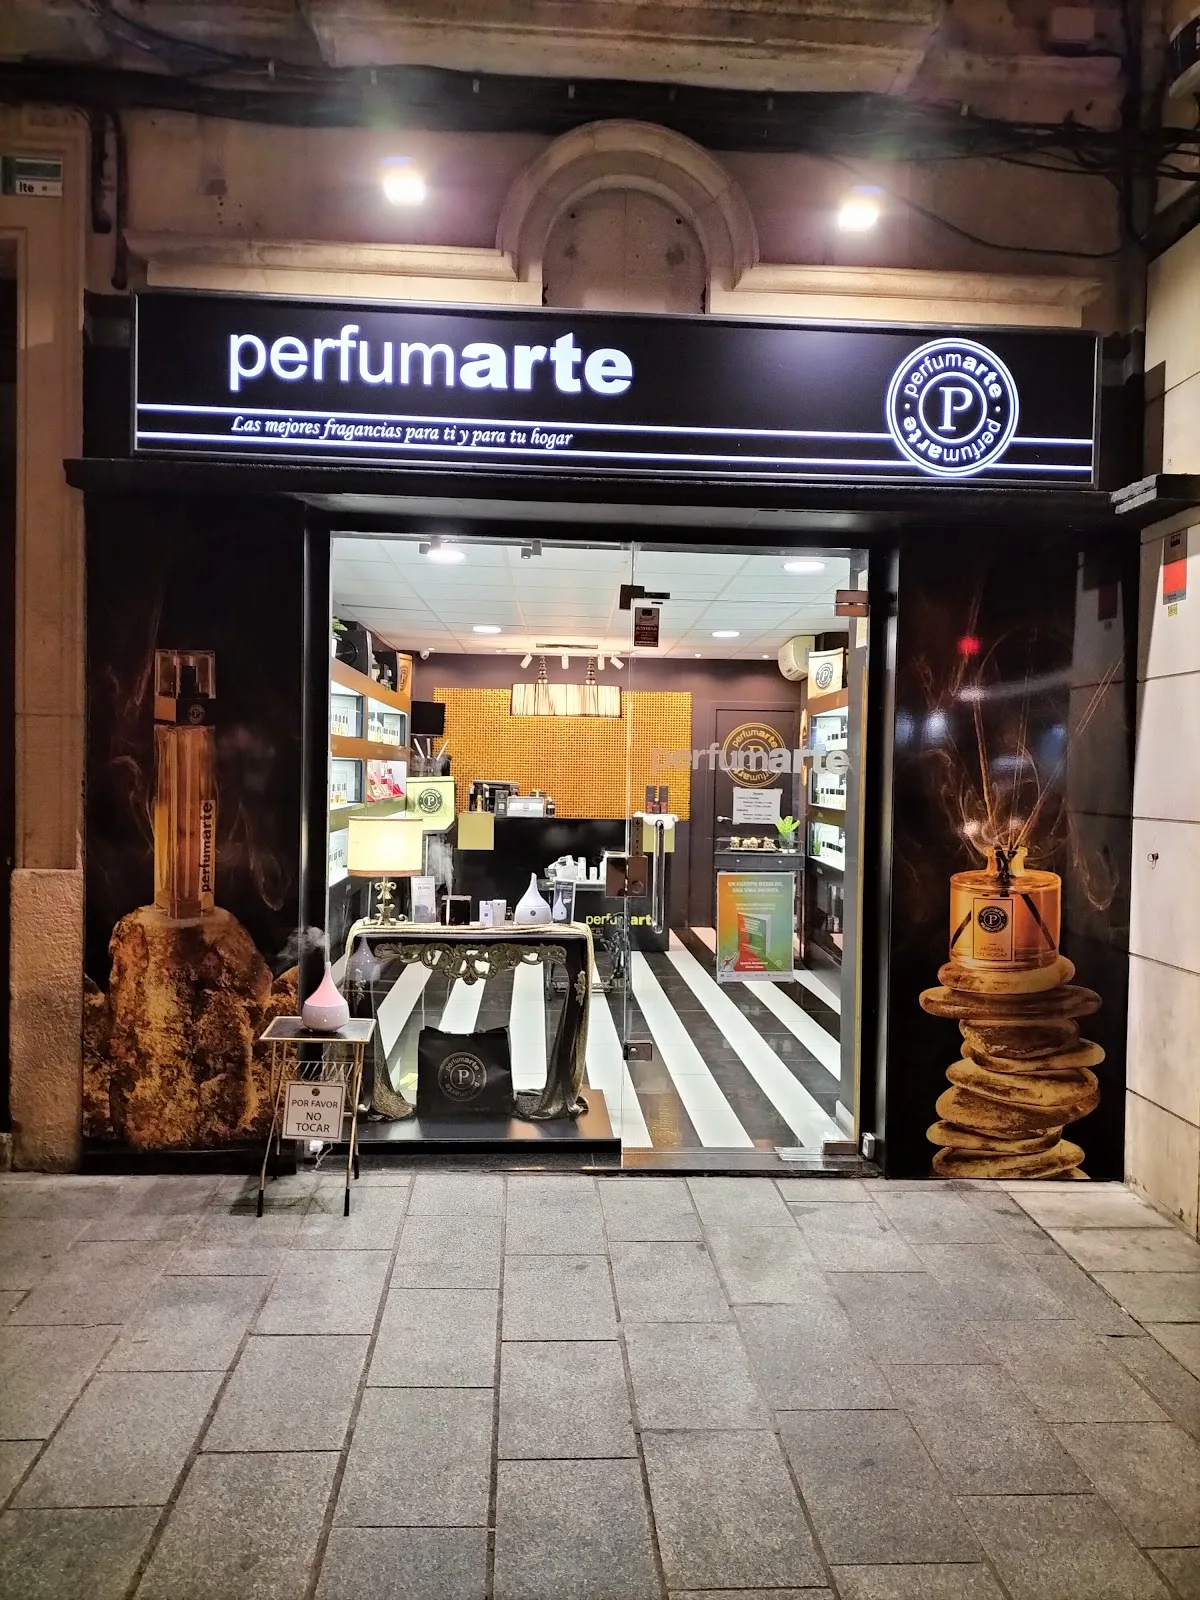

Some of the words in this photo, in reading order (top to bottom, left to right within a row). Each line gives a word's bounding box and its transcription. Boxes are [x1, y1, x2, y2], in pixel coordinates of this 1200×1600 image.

[229, 324, 633, 394] perfumarte
[903, 353, 1002, 398] perfumarte
[938, 386, 973, 430] P
[231, 416, 261, 432] Las
[264, 418, 320, 438] mejores
[319, 418, 402, 440] fragancias
[404, 426, 440, 443] para
[443, 425, 457, 441] ti
[457, 429, 469, 446] y
[471, 429, 506, 447] para
[510, 430, 527, 444] tu
[530, 428, 573, 450] hogar
[903, 415, 1002, 462] perfumarte
[732, 729, 778, 748] perfumarte
[652, 743, 850, 777] perfumarte
[199, 801, 213, 893] perfumarte
[988, 914, 998, 925] P
[458, 1069, 470, 1085] P
[291, 1099, 309, 1107] POR
[310, 1100, 339, 1109] FAVOR
[305, 1112, 322, 1121] NO
[295, 1122, 330, 1133] TOCAR
